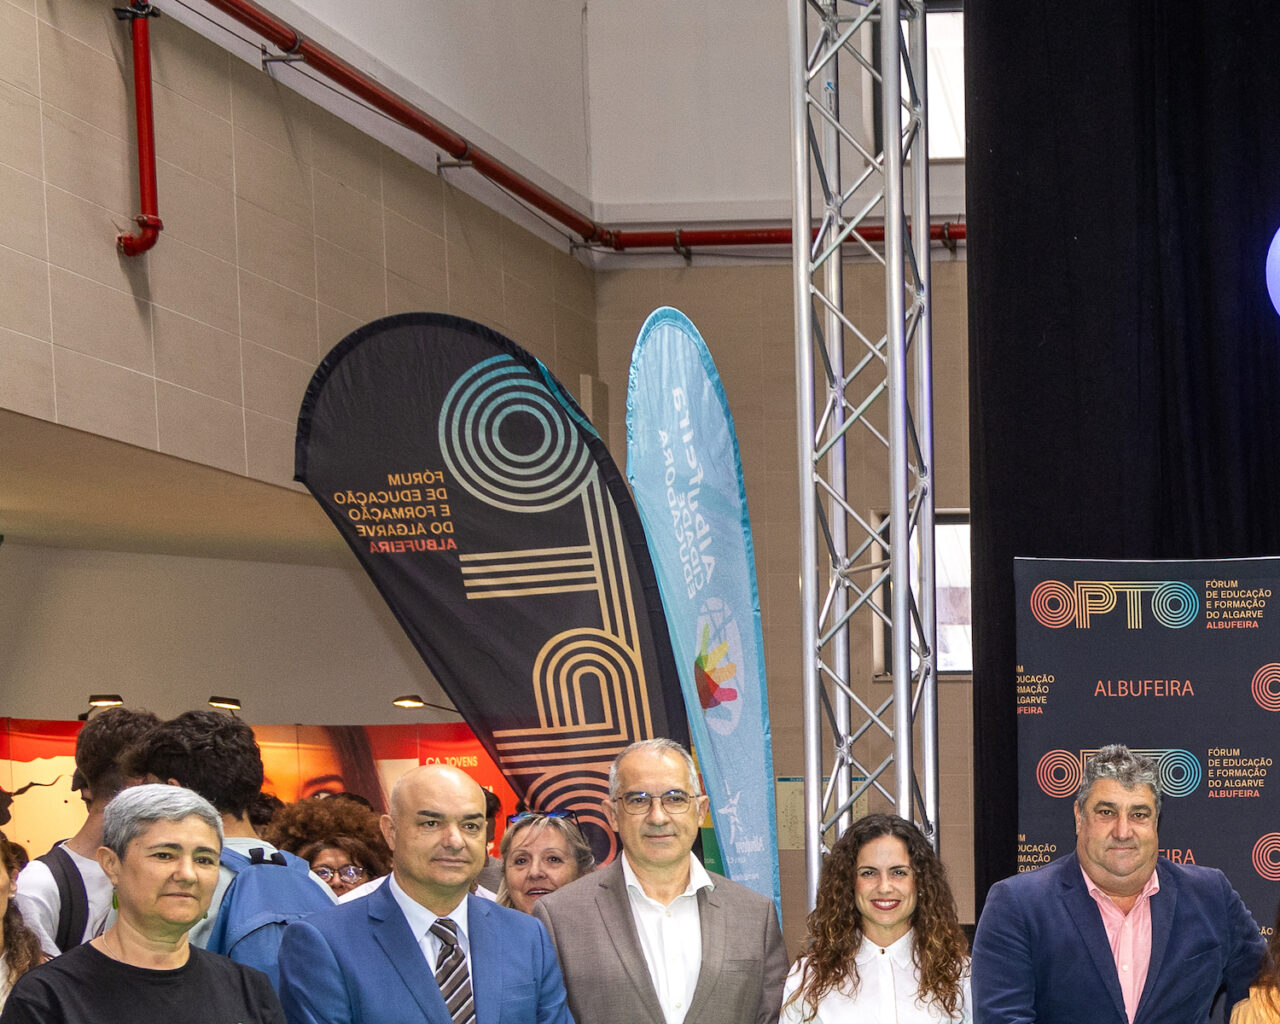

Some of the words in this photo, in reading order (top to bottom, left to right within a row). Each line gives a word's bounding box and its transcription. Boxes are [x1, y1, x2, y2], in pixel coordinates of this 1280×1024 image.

[1205, 577, 1238, 588] FÓRUM
[1206, 590, 1218, 599] DE
[1220, 589, 1272, 600] EDUCAÇÃO
[1030, 579, 1200, 629] OPTO
[1206, 600, 1212, 609] E
[1214, 599, 1266, 610] FORMAÇÃO
[1206, 610, 1220, 619] DO
[1222, 610, 1264, 619] ALGARVE
[1206, 620, 1259, 629] ALBUFEIRA
[1094, 680, 1195, 697] ALBUFEIRA
[1208, 746, 1240, 757] FÓRUM
[1208, 758, 1221, 767] DE
[1223, 757, 1273, 768] EDUCAÇÃO
[1208, 769, 1214, 777] E
[1216, 767, 1267, 778] FORMAÇÃO
[1208, 779, 1222, 788] DO
[1224, 779, 1265, 788] ALGARVE
[1208, 789, 1260, 798] ALBUFEIRA
